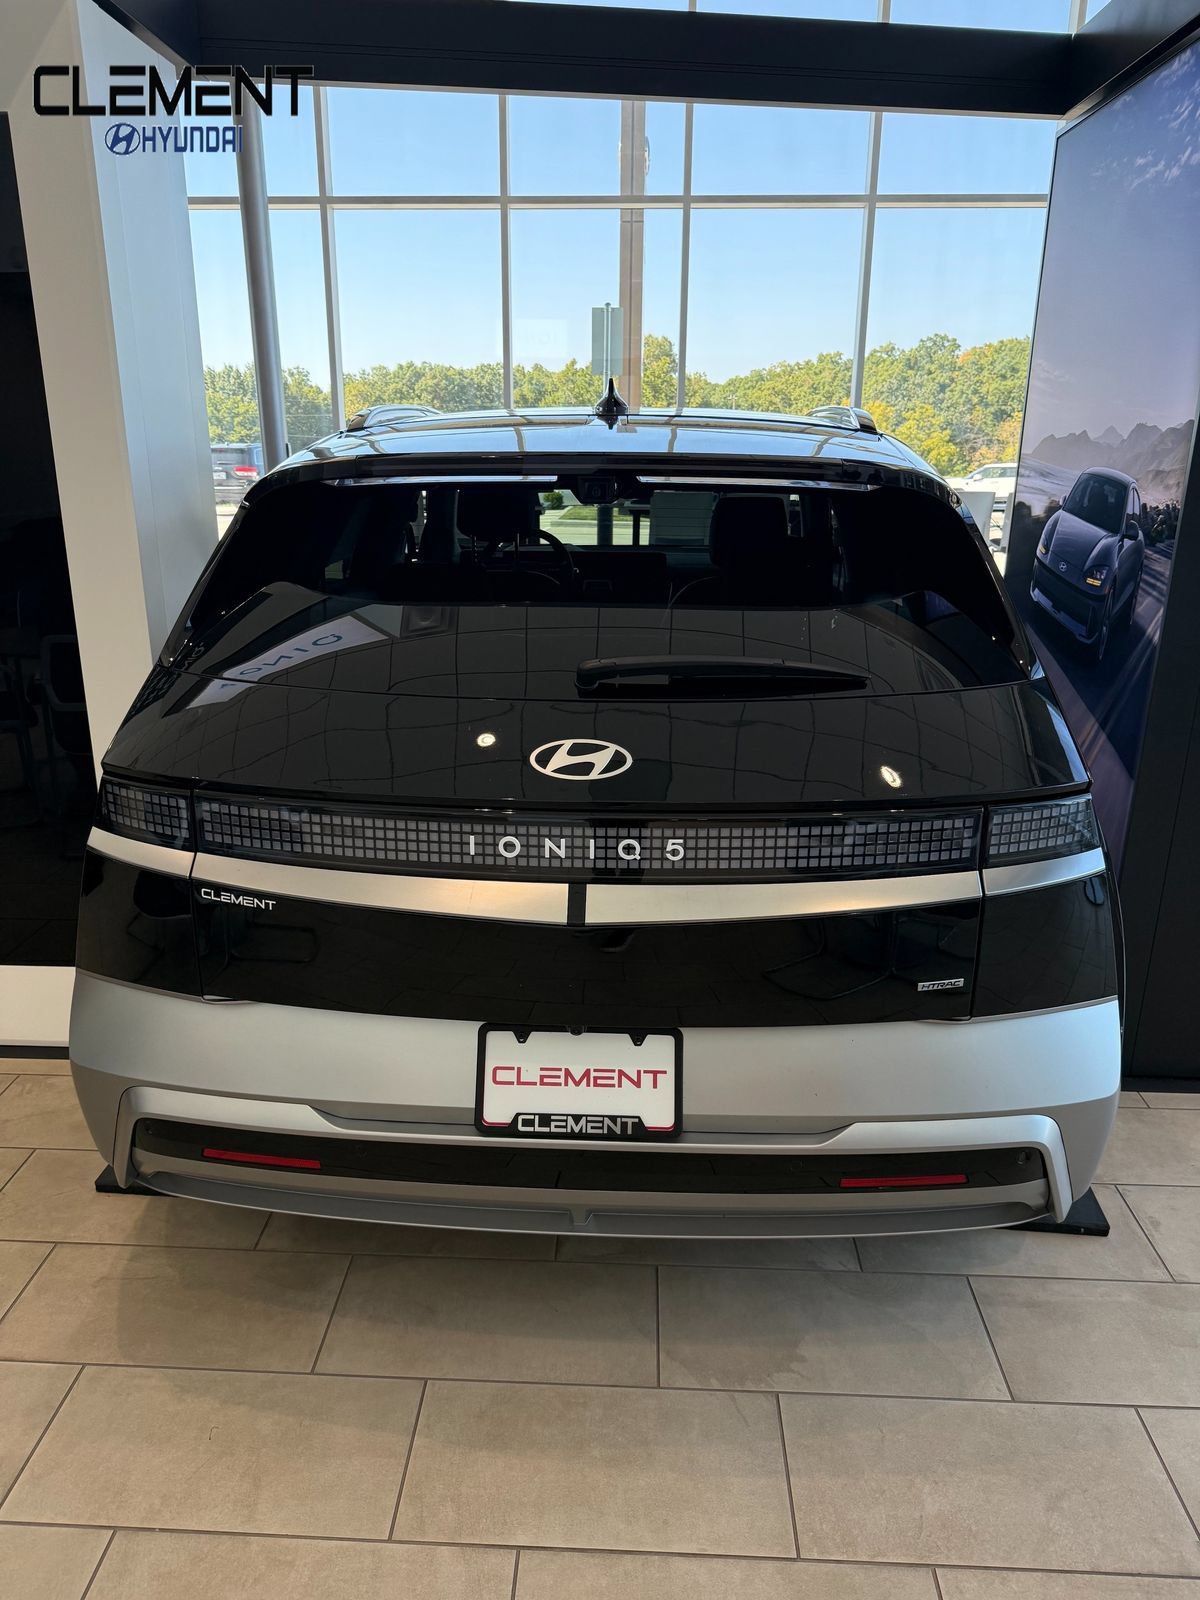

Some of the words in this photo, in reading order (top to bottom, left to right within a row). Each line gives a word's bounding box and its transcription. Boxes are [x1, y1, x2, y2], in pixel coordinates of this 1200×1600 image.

[468, 834, 642, 861] IONIQ
[665, 838, 685, 861] 5
[201, 888, 277, 910] CLEMENT
[491, 1065, 668, 1089] CLEMENT
[517, 1114, 639, 1135] CLEMENT
